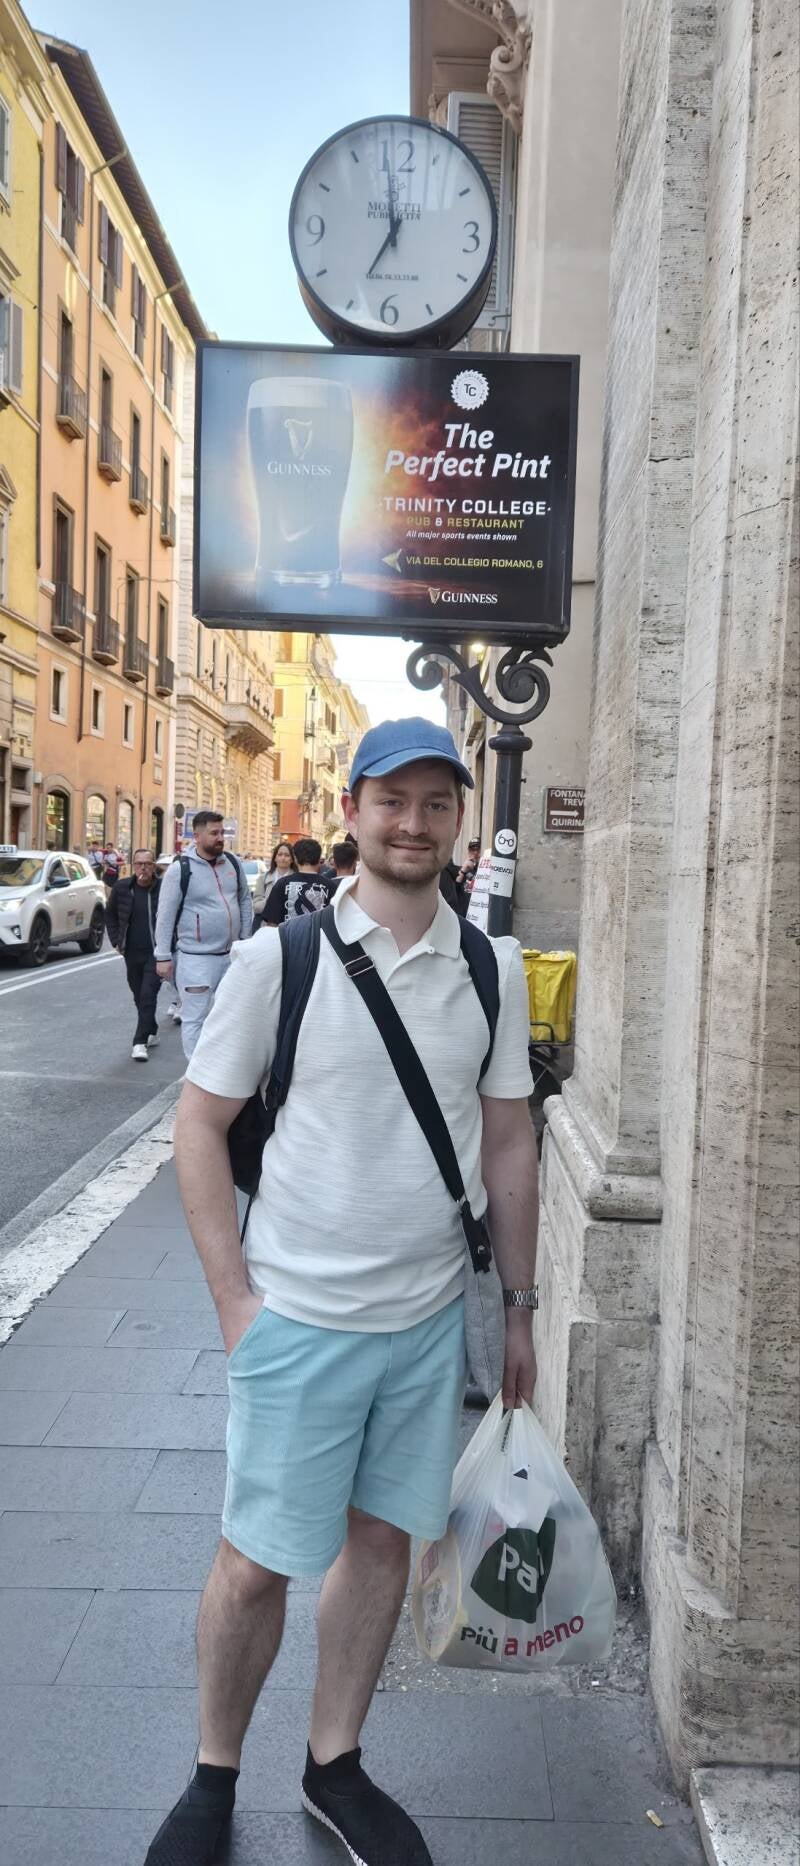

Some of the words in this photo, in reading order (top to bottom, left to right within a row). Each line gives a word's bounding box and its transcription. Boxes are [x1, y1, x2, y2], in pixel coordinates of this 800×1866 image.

[378, 140, 416, 172] 12
[306, 214, 325, 246] 9
[461, 220, 481, 253] 3
[379, 294, 400, 326] 6
[444, 423, 495, 450] The
[267, 461, 331, 477] GUINNESS
[384, 450, 486, 482] Perfect
[491, 453, 552, 479] Pint
[383, 496, 457, 514] TRINITY
[461, 499, 547, 516] COLLEGE
[406, 517, 431, 527] PUB
[435, 517, 443, 527] &
[447, 517, 525, 529] RESTAURANT
[406, 530, 417, 538] All
[417, 531, 440, 540] major
[441, 532, 465, 541] sports
[466, 533, 491, 541] events
[492, 533, 517, 541] shown
[406, 556, 421, 565] VIA
[423, 557, 442, 566] DEL
[443, 557, 490, 568] COLLEGIO
[491, 558, 535, 570] ROMANO,
[441, 591, 498, 604] GUINNESS
[550, 789, 586, 799] FONTAN
[497, 1542, 544, 1595] Pa
[503, 1636, 519, 1657] a
[526, 1614, 585, 1657] meno
